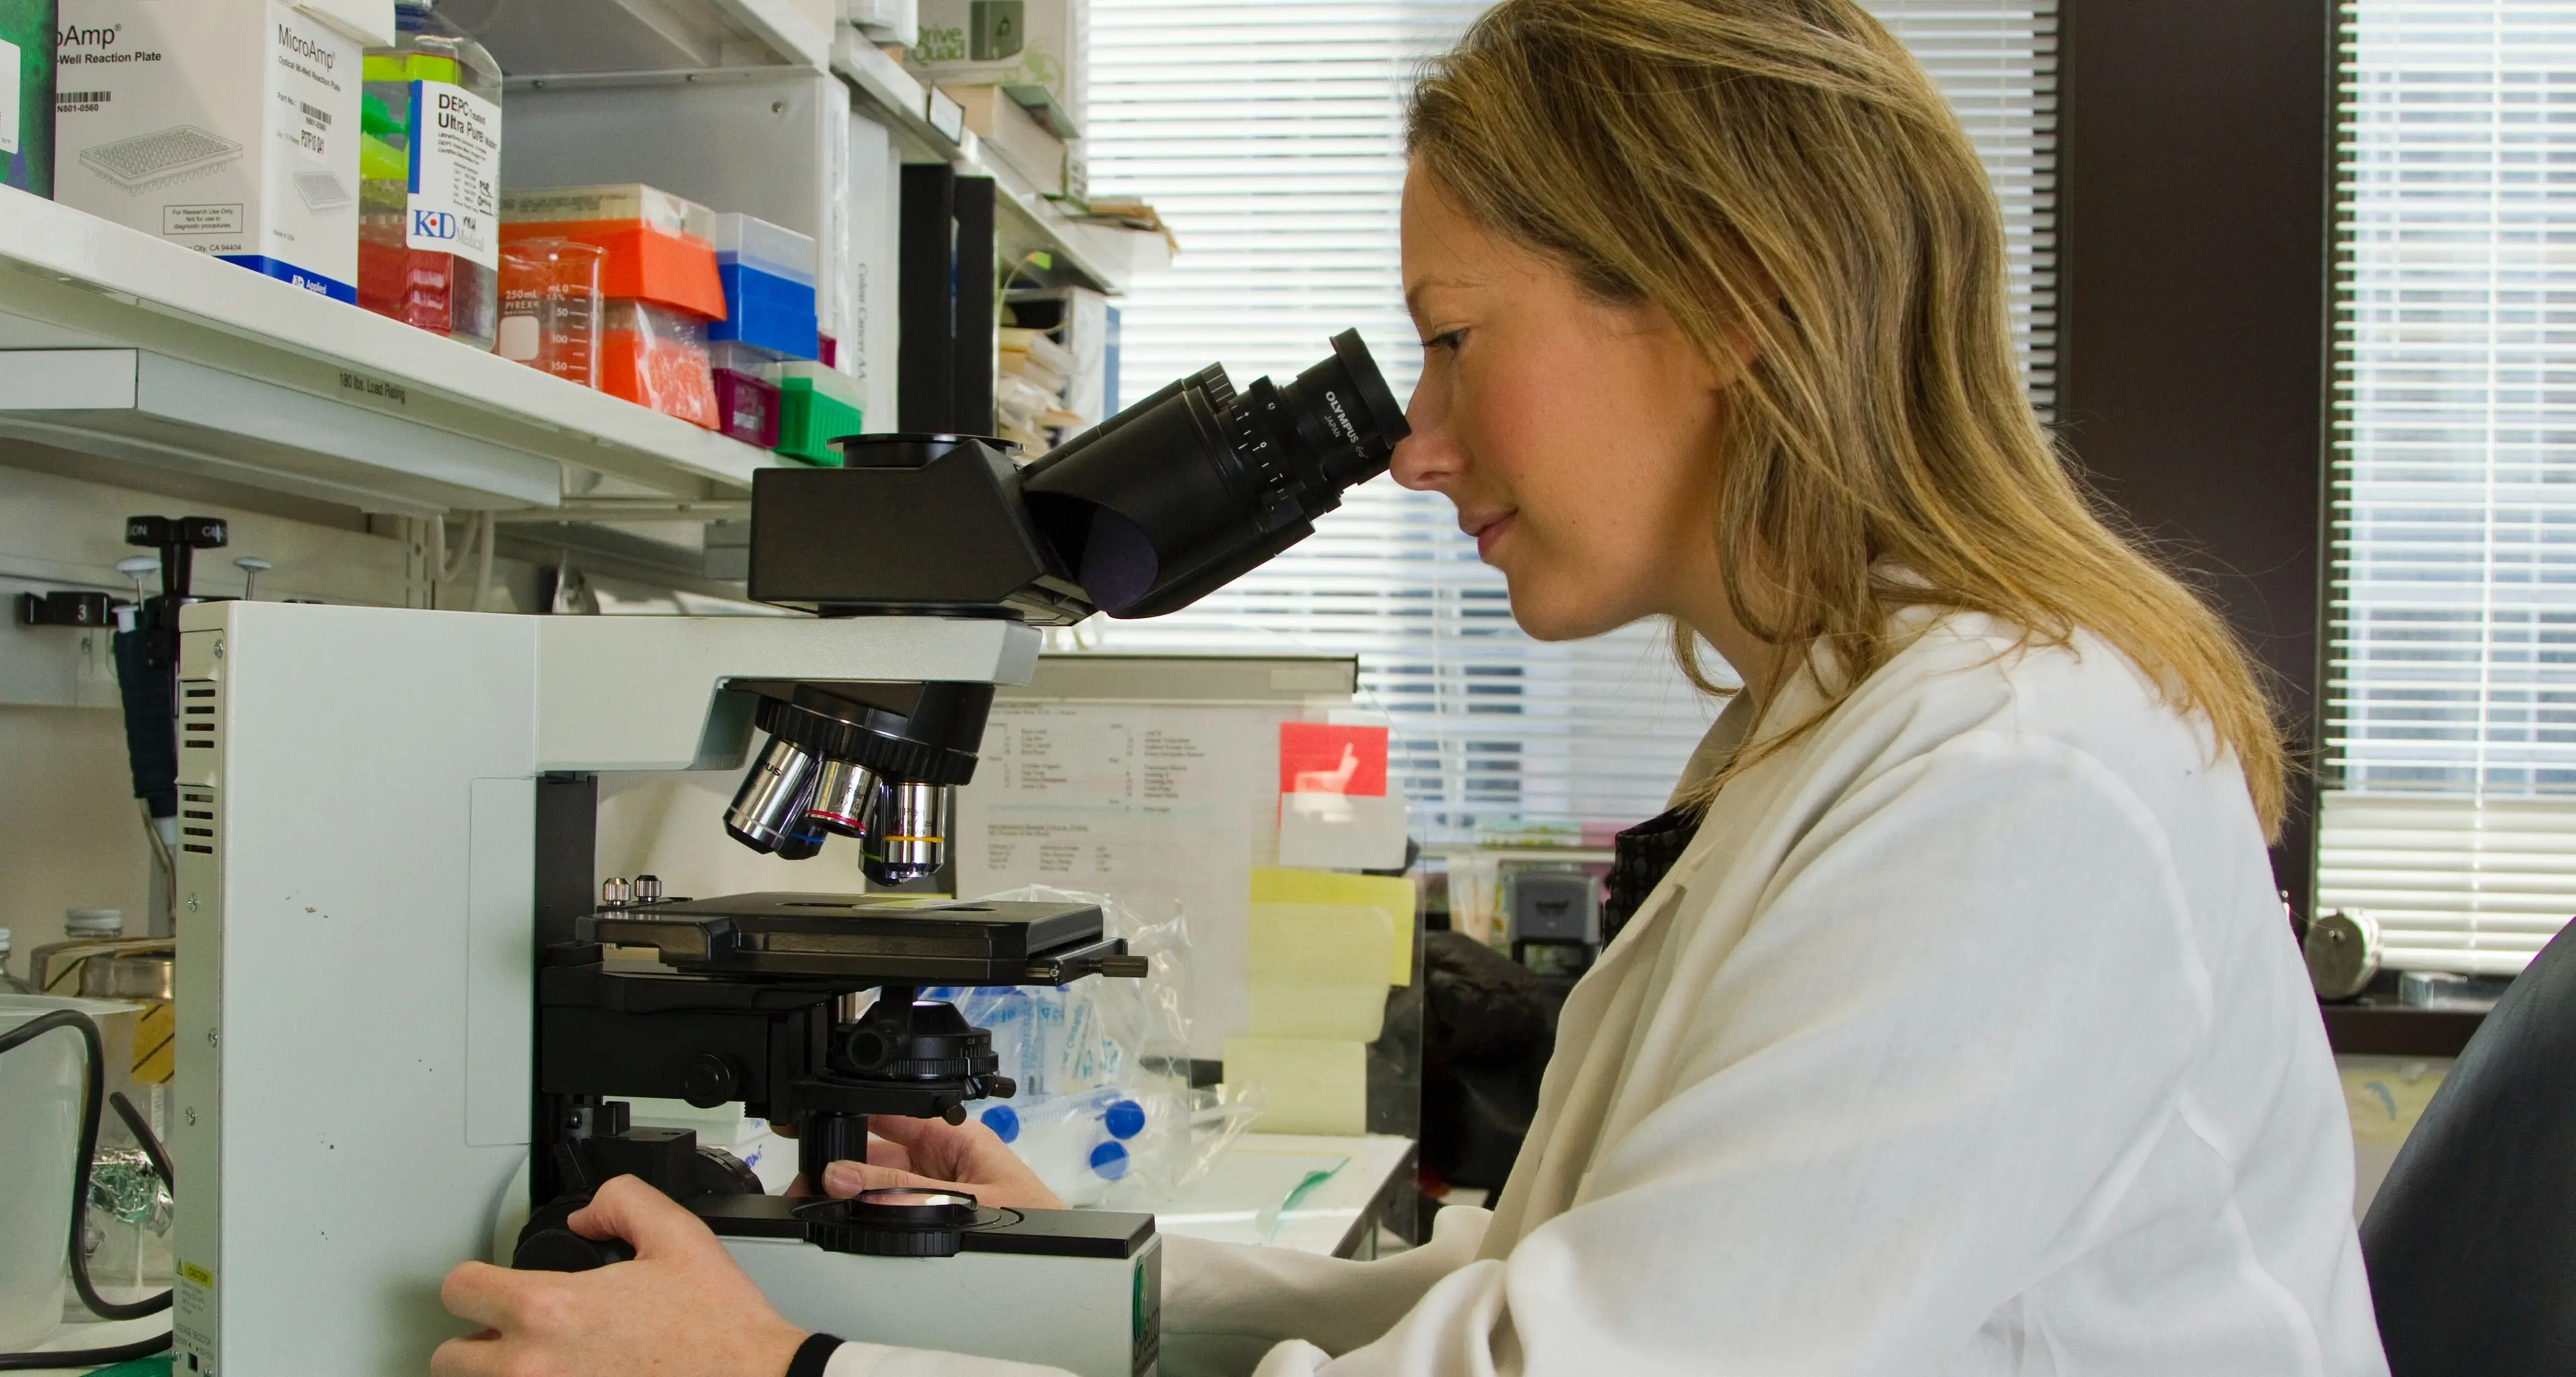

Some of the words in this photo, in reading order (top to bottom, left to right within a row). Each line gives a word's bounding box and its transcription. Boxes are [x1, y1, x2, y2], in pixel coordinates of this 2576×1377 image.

[85, 52, 131, 64] Reaction
[135, 51, 162, 62] Plate
[57, 104, 99, 113] N801-0560
[438, 93, 469, 117] DEPC
[438, 112, 464, 134] Ultra
[467, 121, 484, 144] Pure
[556, 308, 569, 317] 50
[552, 334, 568, 344] 100
[551, 362, 568, 371] 150
[366, 378, 384, 396] Load
[384, 382, 405, 405] Rating
[1326, 390, 1359, 444] OLYMPUS
[1324, 414, 1342, 439] JAPAN
[77, 604, 87, 621] 3
